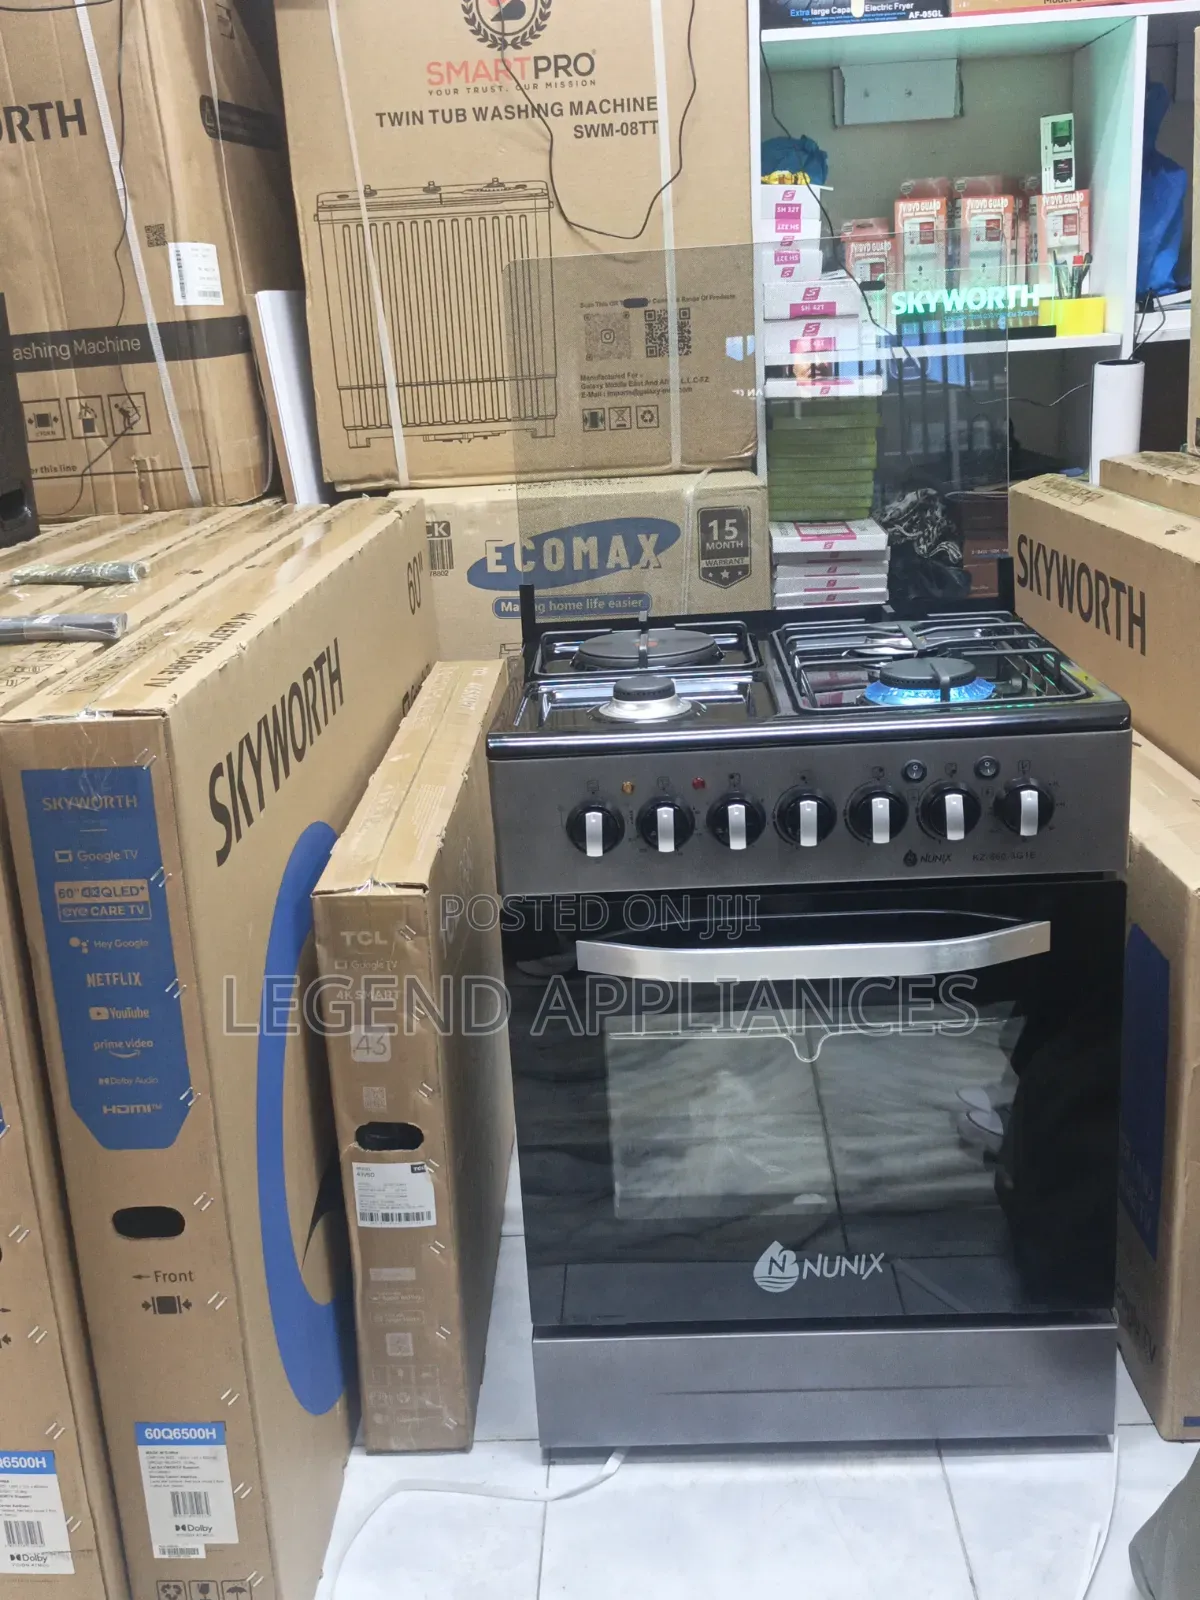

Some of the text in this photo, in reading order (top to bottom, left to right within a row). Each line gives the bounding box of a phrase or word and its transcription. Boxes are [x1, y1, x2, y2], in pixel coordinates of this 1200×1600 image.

[790, 9, 809, 17] Extra
[811, 8, 830, 16] large
[864, 3, 893, 12] Electric
[894, 2, 914, 11] Fryer
[428, 89, 459, 97] YOUR
[515, 82, 539, 92] OUR
[545, 80, 596, 90] MISSION
[376, 96, 658, 128] TWIN TUB WASHING MACHINE
[0, 98, 87, 145] RTH
[573, 120, 659, 139] SWM-08TT
[891, 284, 1039, 315] SKYWORTH
[13, 336, 141, 361] ashing Machine
[40, 465, 58, 473] this
[59, 464, 77, 472] line
[708, 519, 738, 540] 15
[706, 540, 744, 550] MONTH
[486, 533, 662, 573] ECOMAX
[1017, 534, 1146, 656] SKYWORTH
[549, 601, 583, 611] home
[586, 598, 605, 609] life
[608, 597, 643, 608] easier
[208, 637, 344, 868] SKYWORTH
[42, 795, 137, 812] SKYWORTH
[77, 850, 138, 863] Google TV
[91, 905, 125, 916] CARE
[129, 904, 145, 915] TV
[94, 939, 148, 950] Hey Google
[340, 931, 388, 946] TCL
[351, 960, 384, 971] Google
[86, 972, 142, 987] NETFLIX
[355, 989, 401, 1000] SMART
[109, 1007, 149, 1019] YouTube
[94, 1038, 153, 1050] prime video
[111, 1076, 158, 1086] Dolby Audio
[803, 1253, 885, 1280] NUNIX
[154, 1270, 196, 1282] Front
[144, 1427, 217, 1440] 60Q6500H
[187, 1524, 213, 1533] Dolby
[22, 1553, 48, 1564] Dolby
